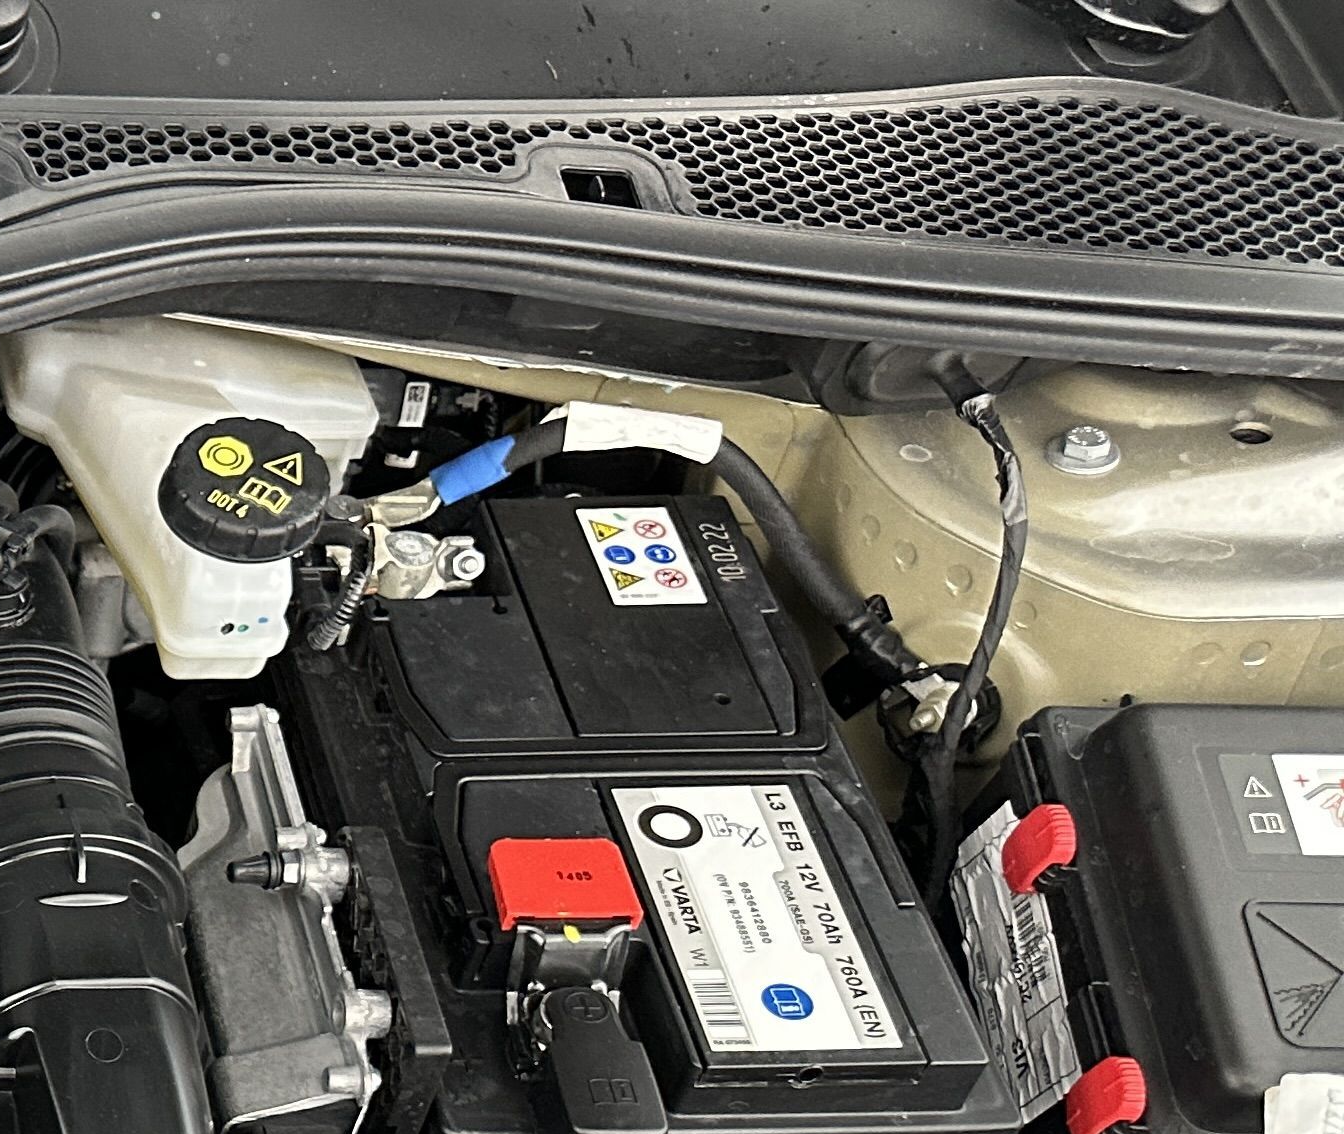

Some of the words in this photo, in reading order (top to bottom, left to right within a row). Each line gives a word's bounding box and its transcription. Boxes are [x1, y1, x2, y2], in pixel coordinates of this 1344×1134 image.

[207, 489, 239, 512] DOT
[235, 504, 249, 518] 4
[698, 523, 747, 583] 10.02.22
[670, 886, 702, 935] VARTA
[765, 792, 787, 811] L3
[777, 820, 804, 852] EFB
[795, 863, 823, 893] 12V
[813, 902, 842, 946] 70Ah
[835, 955, 868, 999] 760A
[853, 1004, 887, 1038] (EN)
[689, 947, 710, 967] W1
